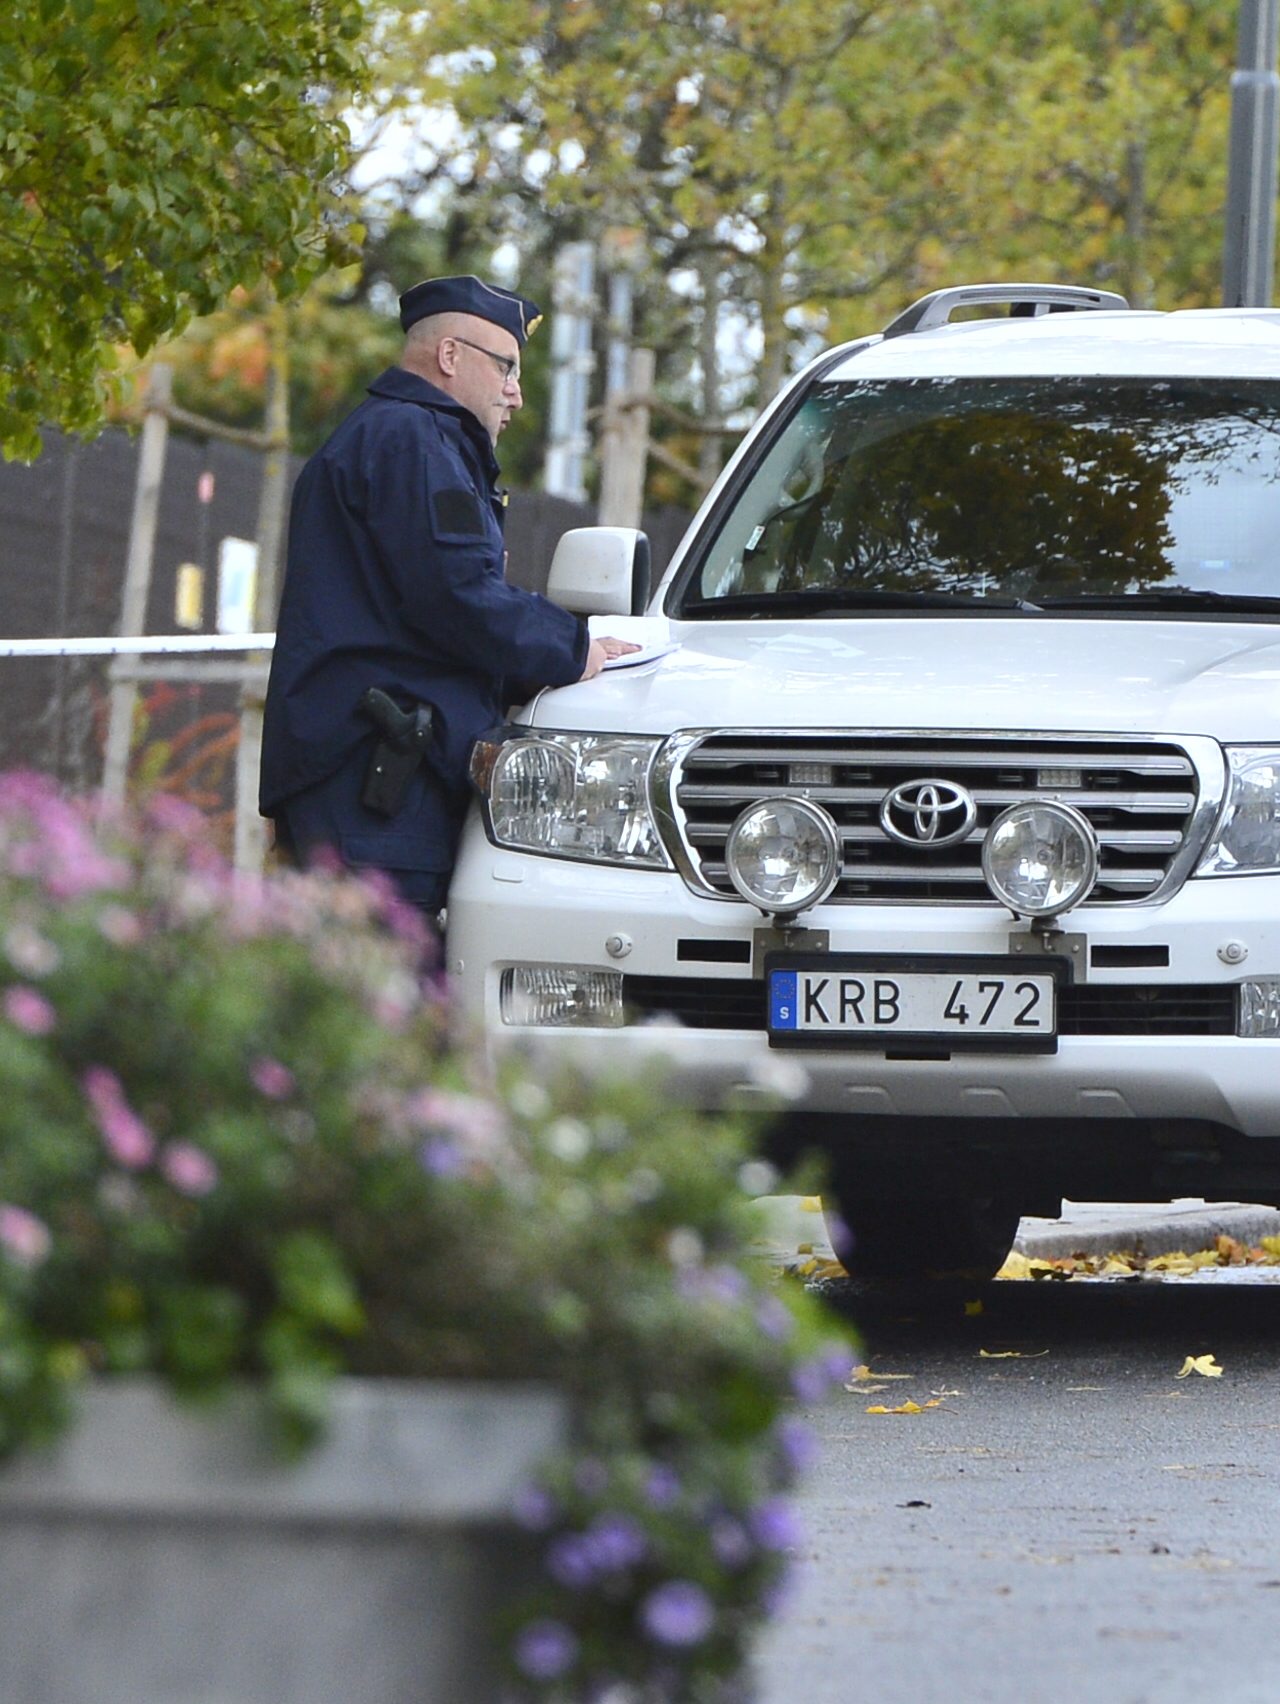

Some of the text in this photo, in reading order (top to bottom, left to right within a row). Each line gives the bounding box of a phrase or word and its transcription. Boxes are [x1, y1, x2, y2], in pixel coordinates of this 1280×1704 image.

[779, 1006, 789, 1020] S
[804, 978, 1040, 1027] KRB 472
